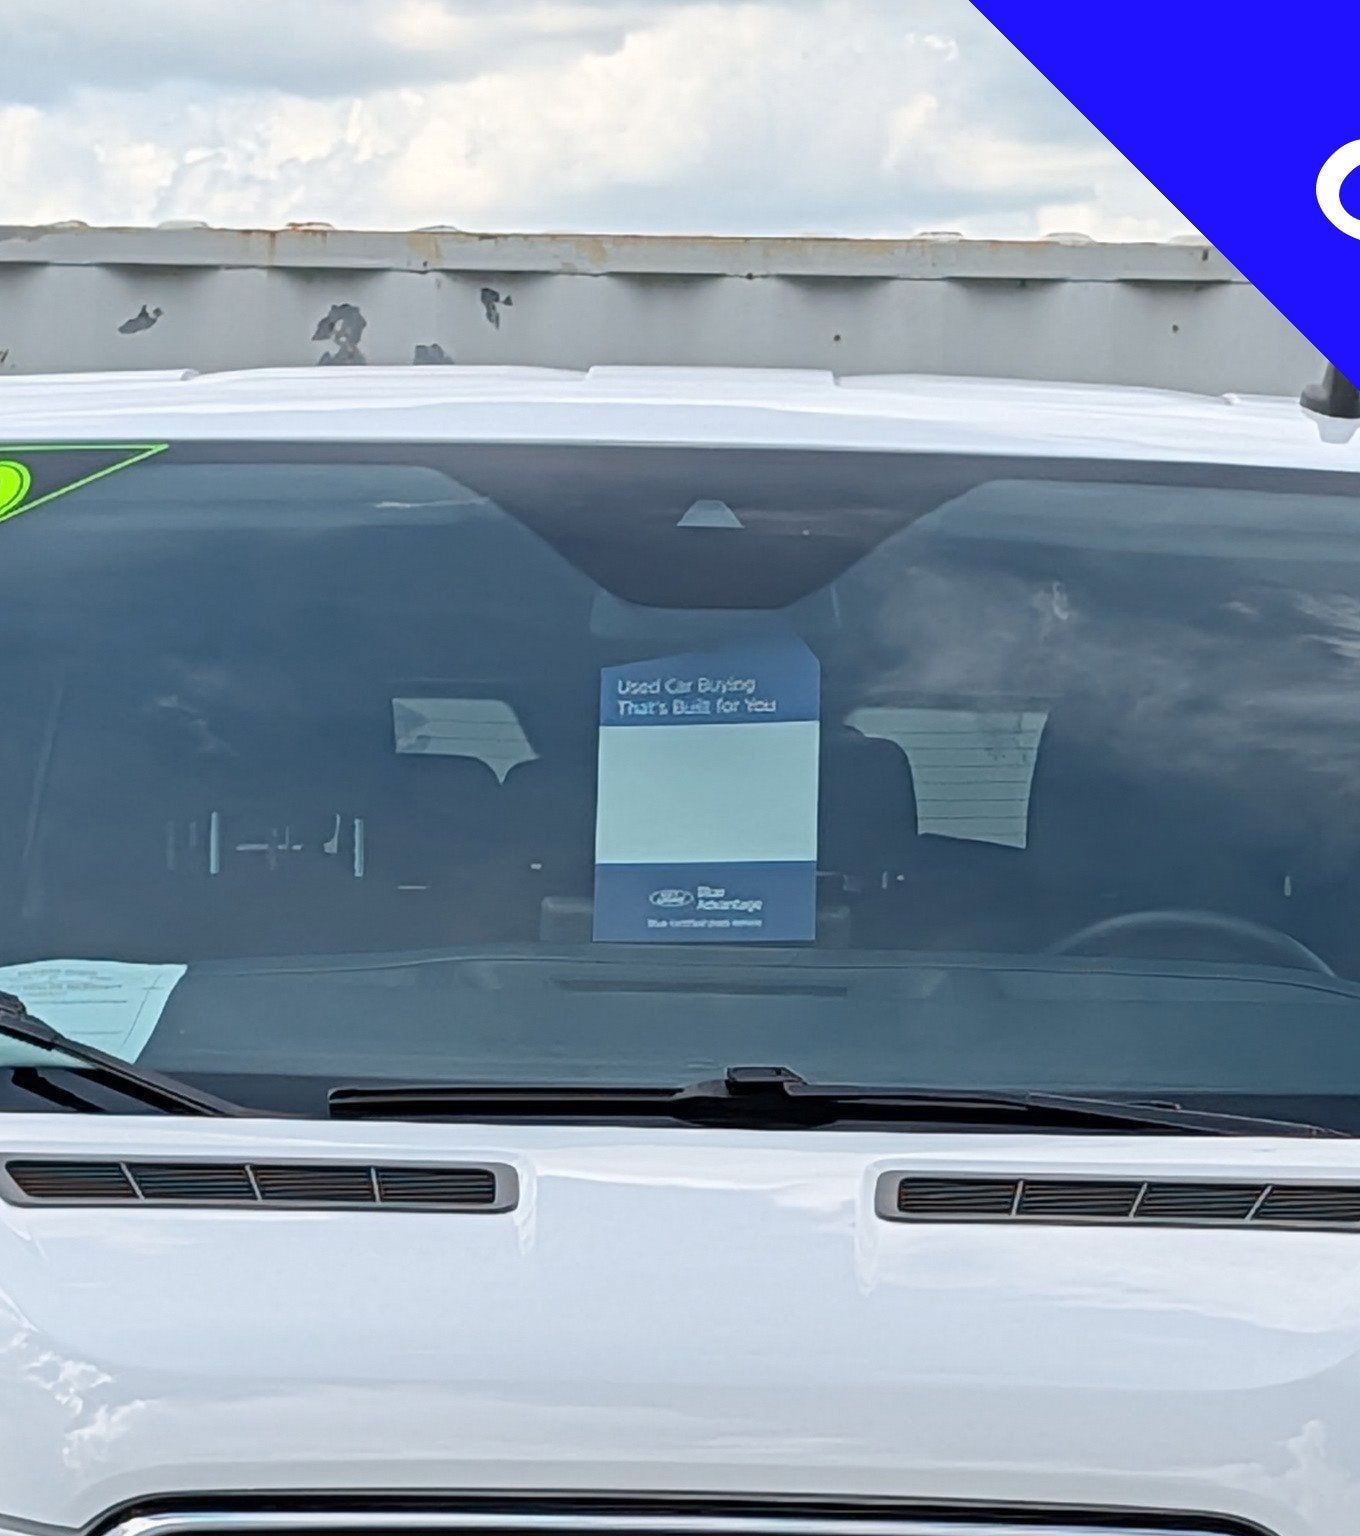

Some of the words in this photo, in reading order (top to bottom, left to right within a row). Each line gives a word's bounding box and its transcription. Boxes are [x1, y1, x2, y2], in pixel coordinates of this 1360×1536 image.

[617, 678, 661, 695] Used
[664, 677, 694, 695] Car
[697, 677, 756, 695] Buying
[617, 699, 669, 716] That's
[672, 698, 711, 716] Built
[716, 697, 740, 714] for
[744, 698, 778, 713] You
